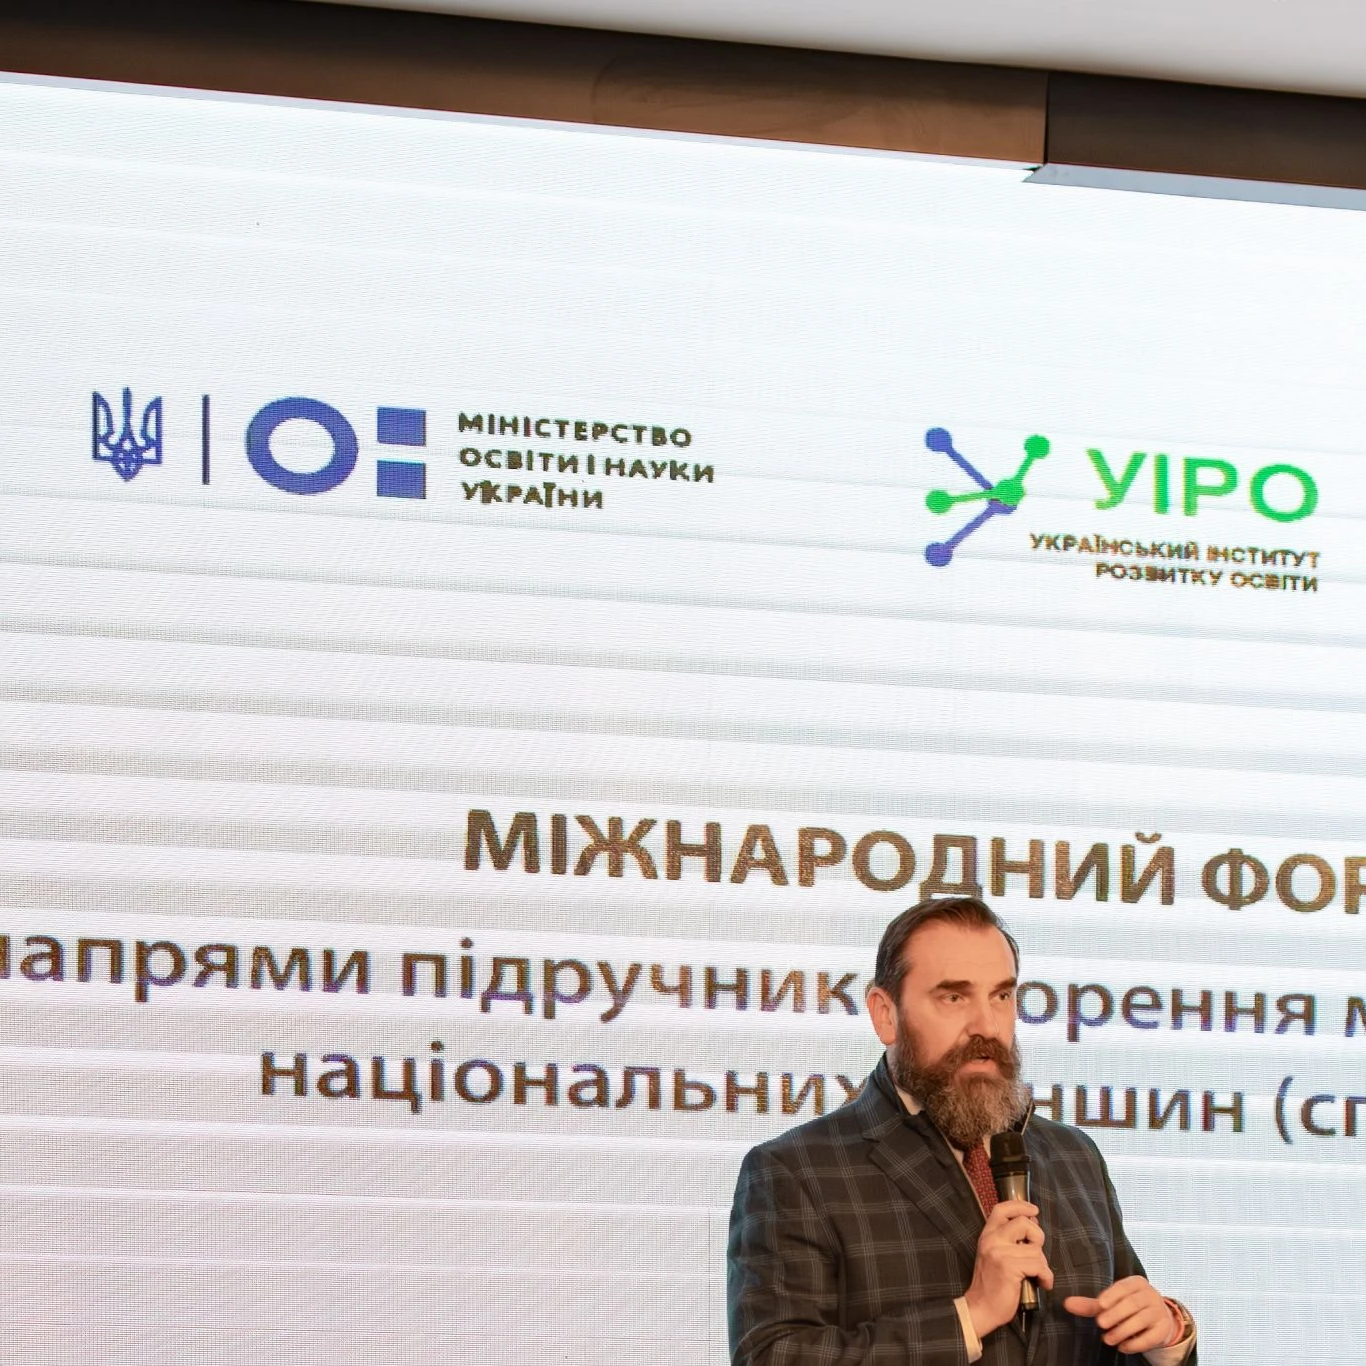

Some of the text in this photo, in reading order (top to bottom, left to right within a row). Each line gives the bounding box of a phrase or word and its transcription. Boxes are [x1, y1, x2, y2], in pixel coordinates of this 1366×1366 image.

[458, 411, 692, 448] МІНІСТЕРСТВО
[459, 447, 715, 483] ОСВІТИ І НАУКИ
[461, 480, 603, 509] УКРАЇНИ
[1086, 448, 1319, 522] УІРО
[1029, 532, 1320, 569] УКРАЇНСЬКИЙ ІНСТИТУТ
[1096, 562, 1319, 592] РОЗВИТКУ ОСВІТИ
[465, 808, 1176, 906] МІЖНАРОДНИЙ
[401, 937, 1317, 1042] підручникорення
